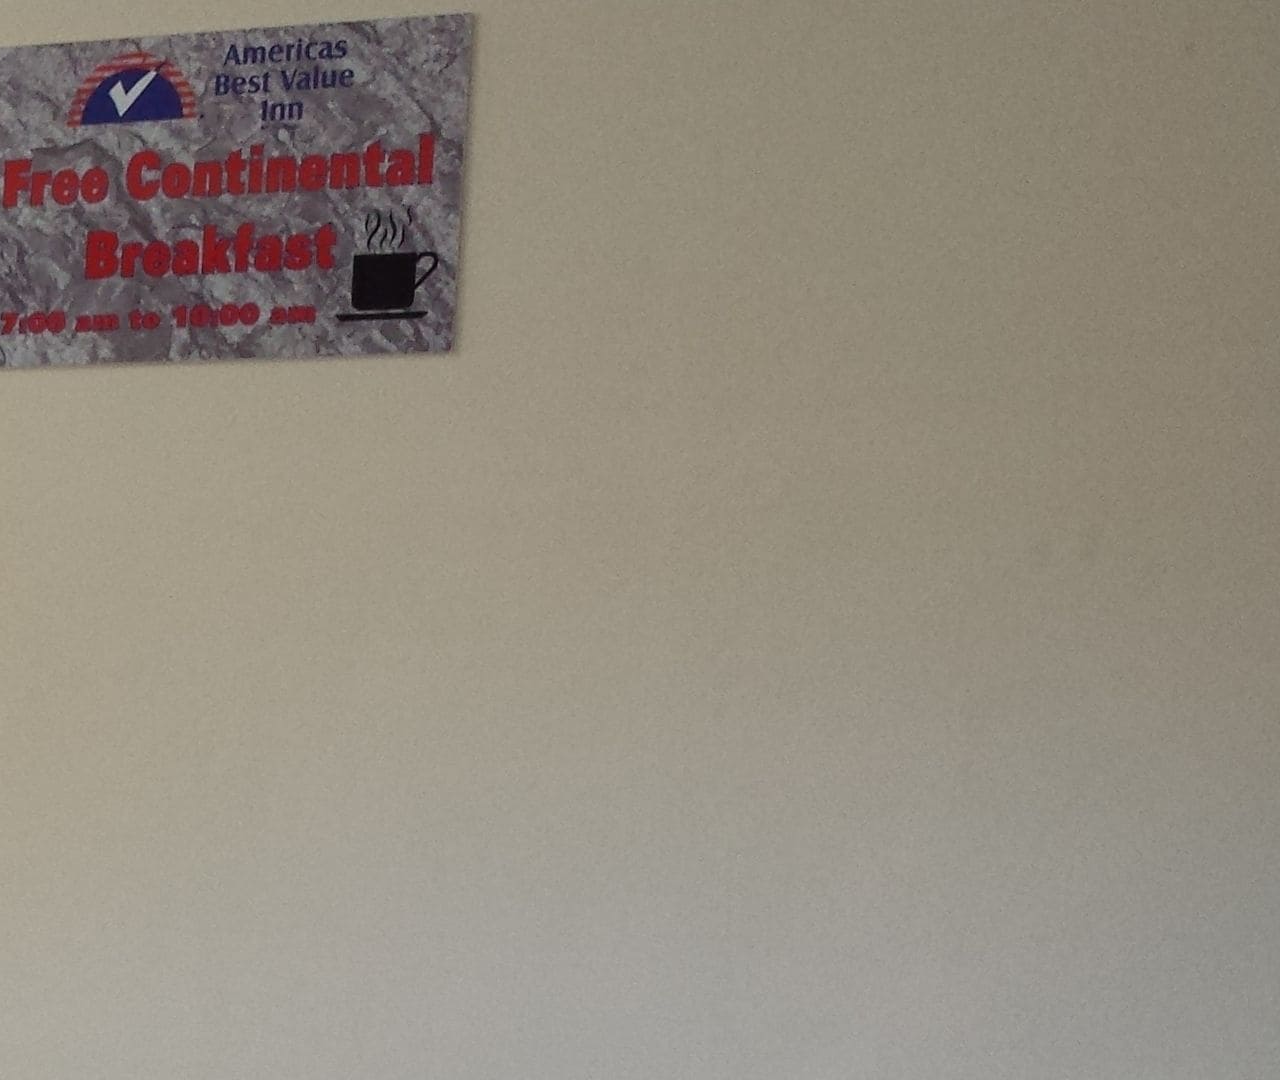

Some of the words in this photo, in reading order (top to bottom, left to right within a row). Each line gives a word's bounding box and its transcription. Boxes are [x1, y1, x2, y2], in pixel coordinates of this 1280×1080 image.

[223, 37, 348, 66] Americas
[214, 71, 271, 97] Best
[280, 64, 356, 91] Value
[259, 99, 304, 122] Inn
[1, 157, 110, 209] Free
[125, 132, 435, 201] Continental
[84, 221, 339, 281] Breakfast
[0, 310, 66, 336] 7:00
[74, 312, 120, 333] am
[128, 308, 161, 330] to
[171, 301, 261, 328] 10:00
[269, 304, 317, 325] am
